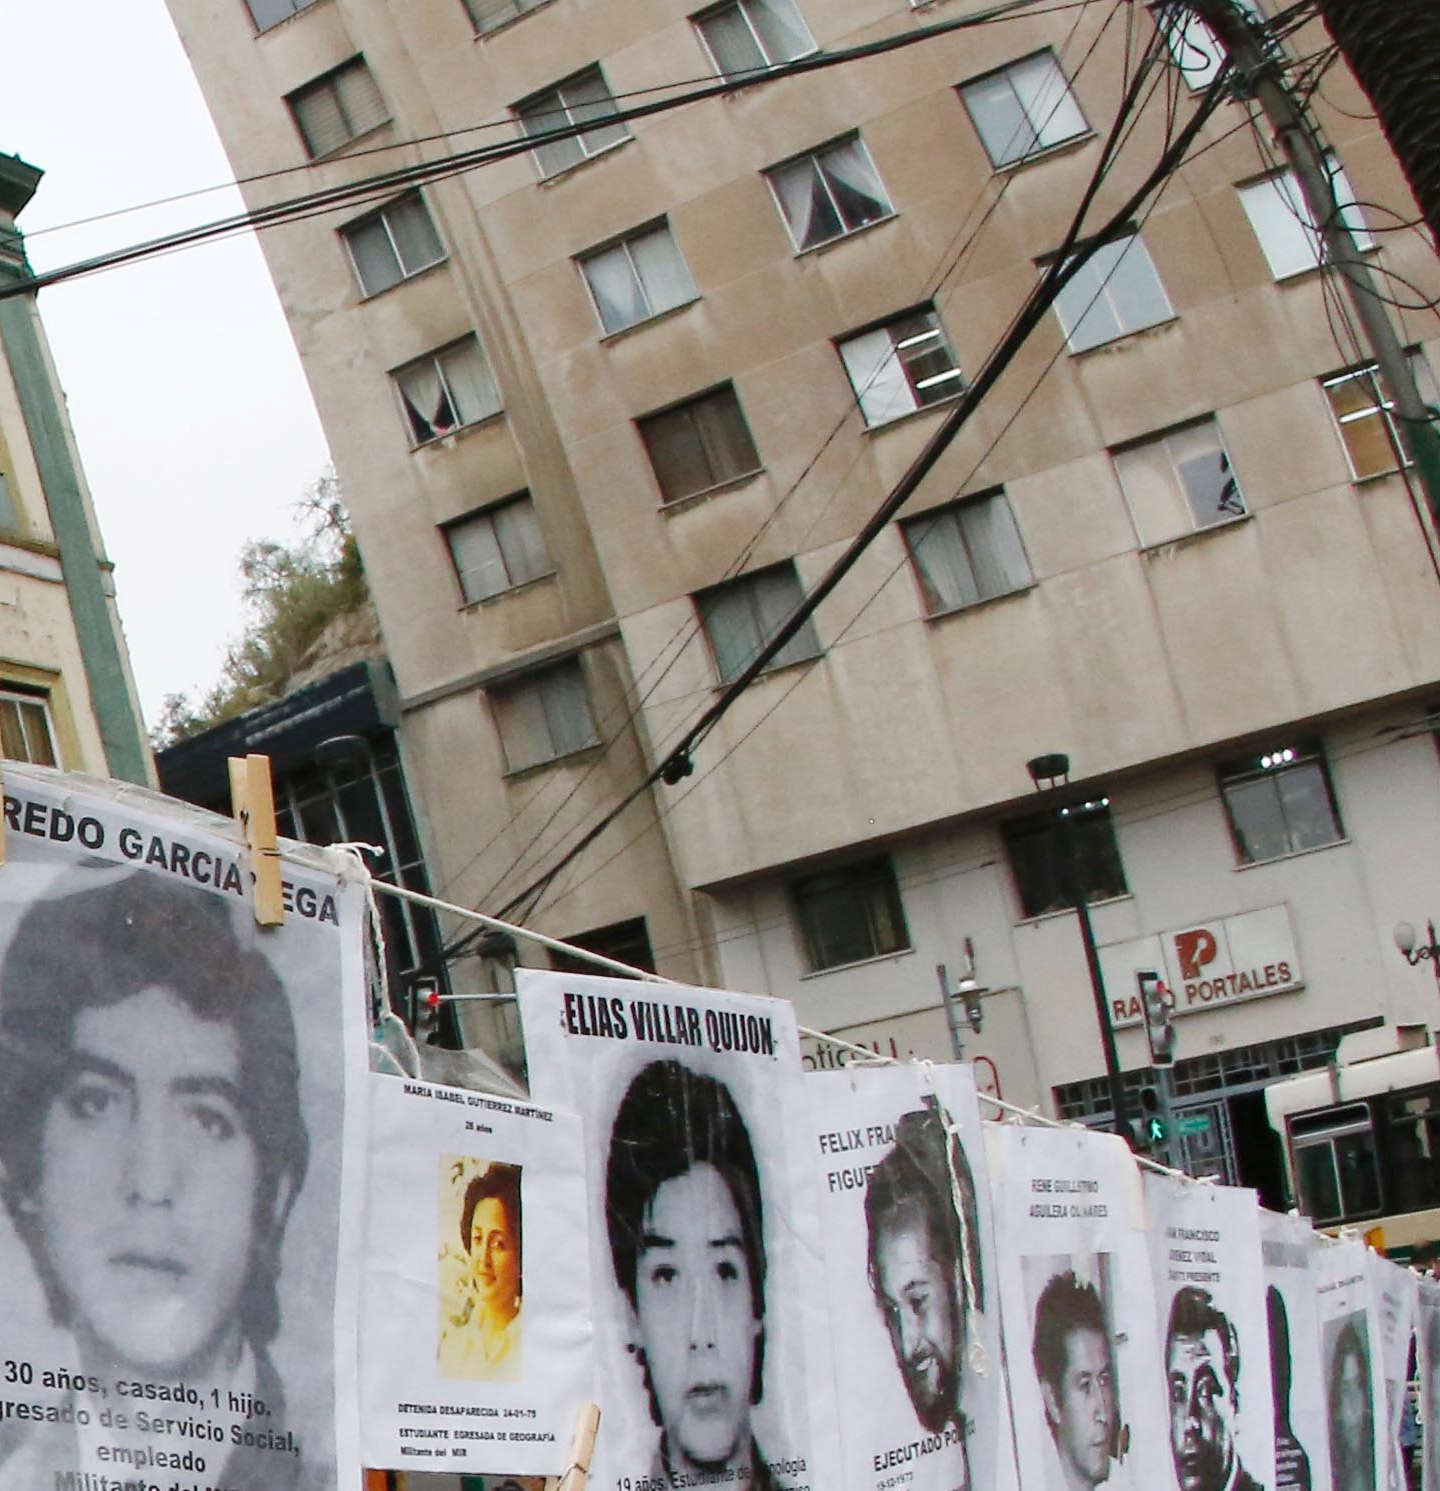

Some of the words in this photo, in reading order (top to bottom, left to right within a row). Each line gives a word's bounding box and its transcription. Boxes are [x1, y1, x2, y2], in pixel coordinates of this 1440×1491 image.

[120, 826, 244, 897] GARCIA
[251, 870, 340, 927] EGA
[1185, 961, 1292, 1005] PORTALES
[563, 993, 628, 1039] ELIAS
[630, 1000, 703, 1047] VILLAR
[705, 1009, 775, 1056] QUIJON
[434, 1089, 465, 1105] ISABEL
[467, 1096, 513, 1114] GUTIERREZ
[819, 1128, 865, 1155] FELIX
[4, 1359, 35, 1386] 30
[42, 1367, 107, 1400] años,
[116, 1377, 205, 1409] casado,
[210, 1387, 221, 1409] 1
[228, 1389, 271, 1421] hijo.
[398, 1403, 438, 1415] DETENIDA
[439, 1405, 499, 1418] DESAPARECIDA
[99, 1406, 130, 1430] de
[137, 1415, 225, 1444] Servicio
[230, 1424, 300, 1457] Social,
[399, 1427, 450, 1440] ESTUDIANTE
[453, 1429, 495, 1441] EGRESADA
[496, 1431, 508, 1441] DE
[96, 1443, 206, 1473] empleado
[874, 1435, 942, 1472] EJECUTADO
[737, 1466, 752, 1481] de
